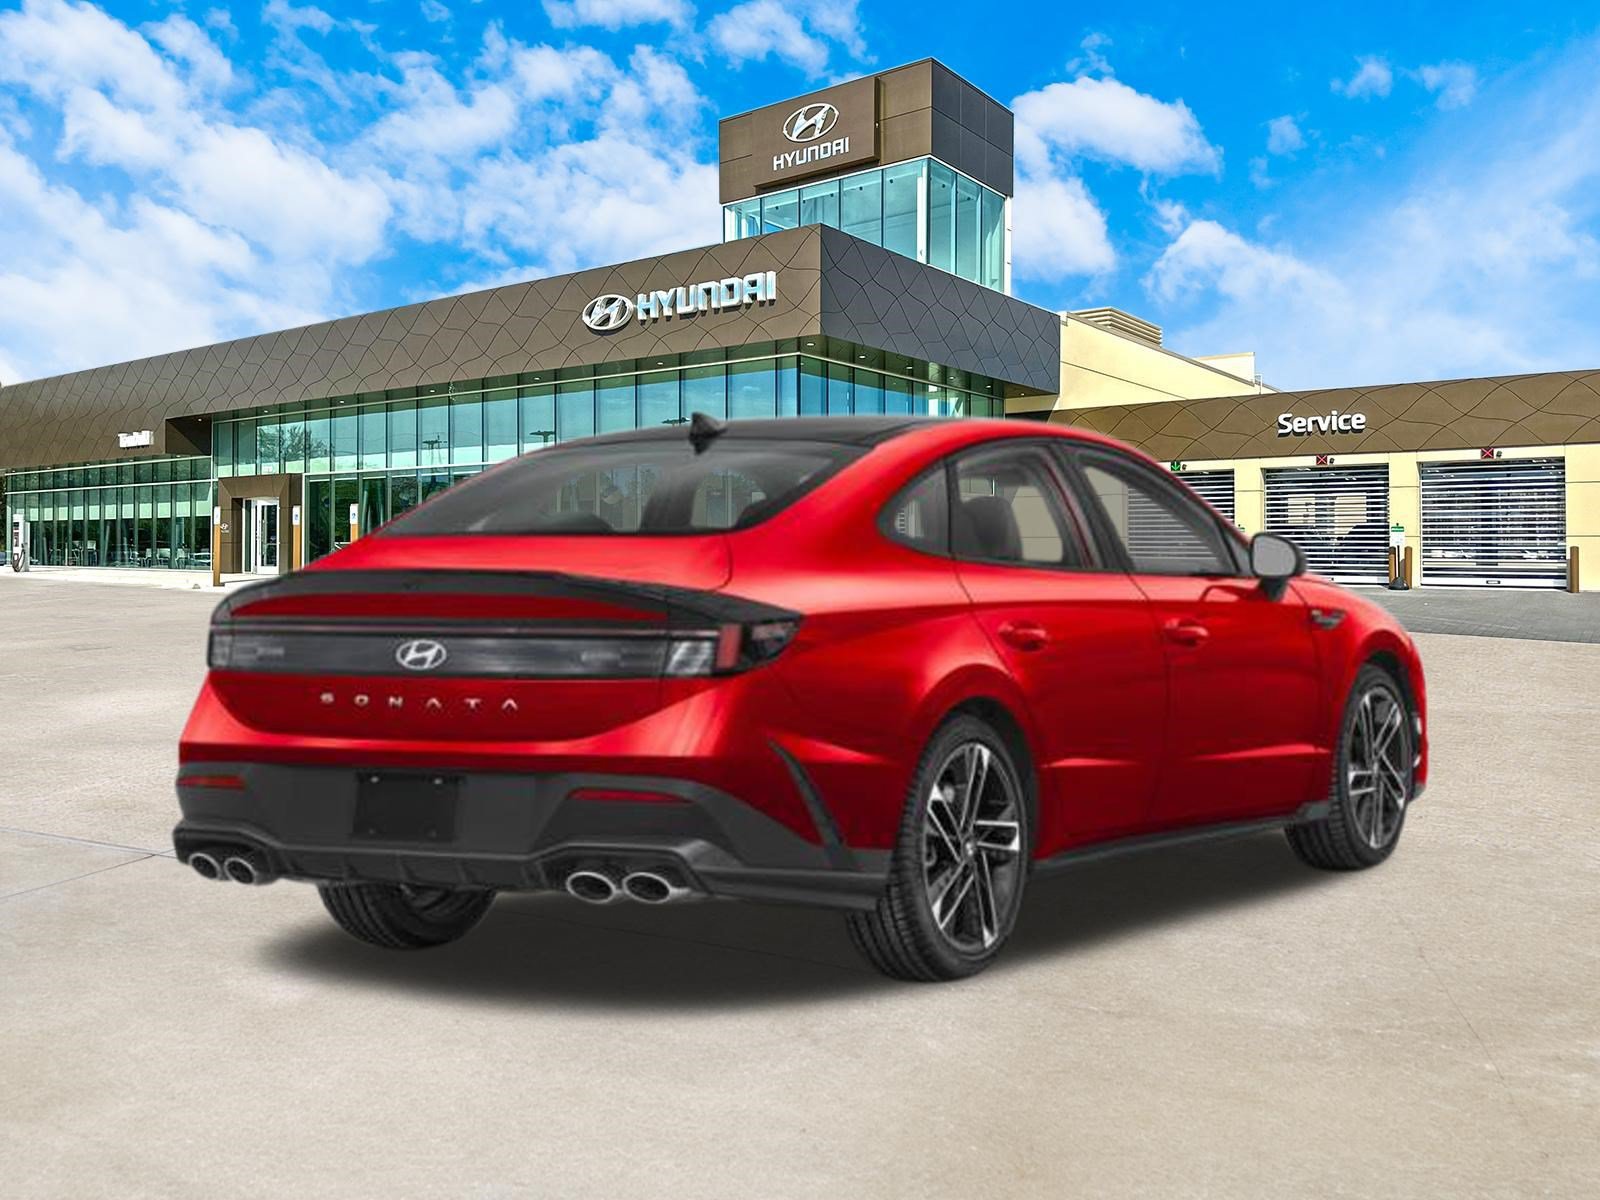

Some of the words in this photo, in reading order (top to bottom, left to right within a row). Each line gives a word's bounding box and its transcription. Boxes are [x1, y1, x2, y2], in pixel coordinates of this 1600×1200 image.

[773, 136, 850, 171] HYUNDAI
[637, 270, 777, 321] HYUNDAI
[1277, 410, 1366, 434] Service
[320, 692, 518, 710] SONATA
